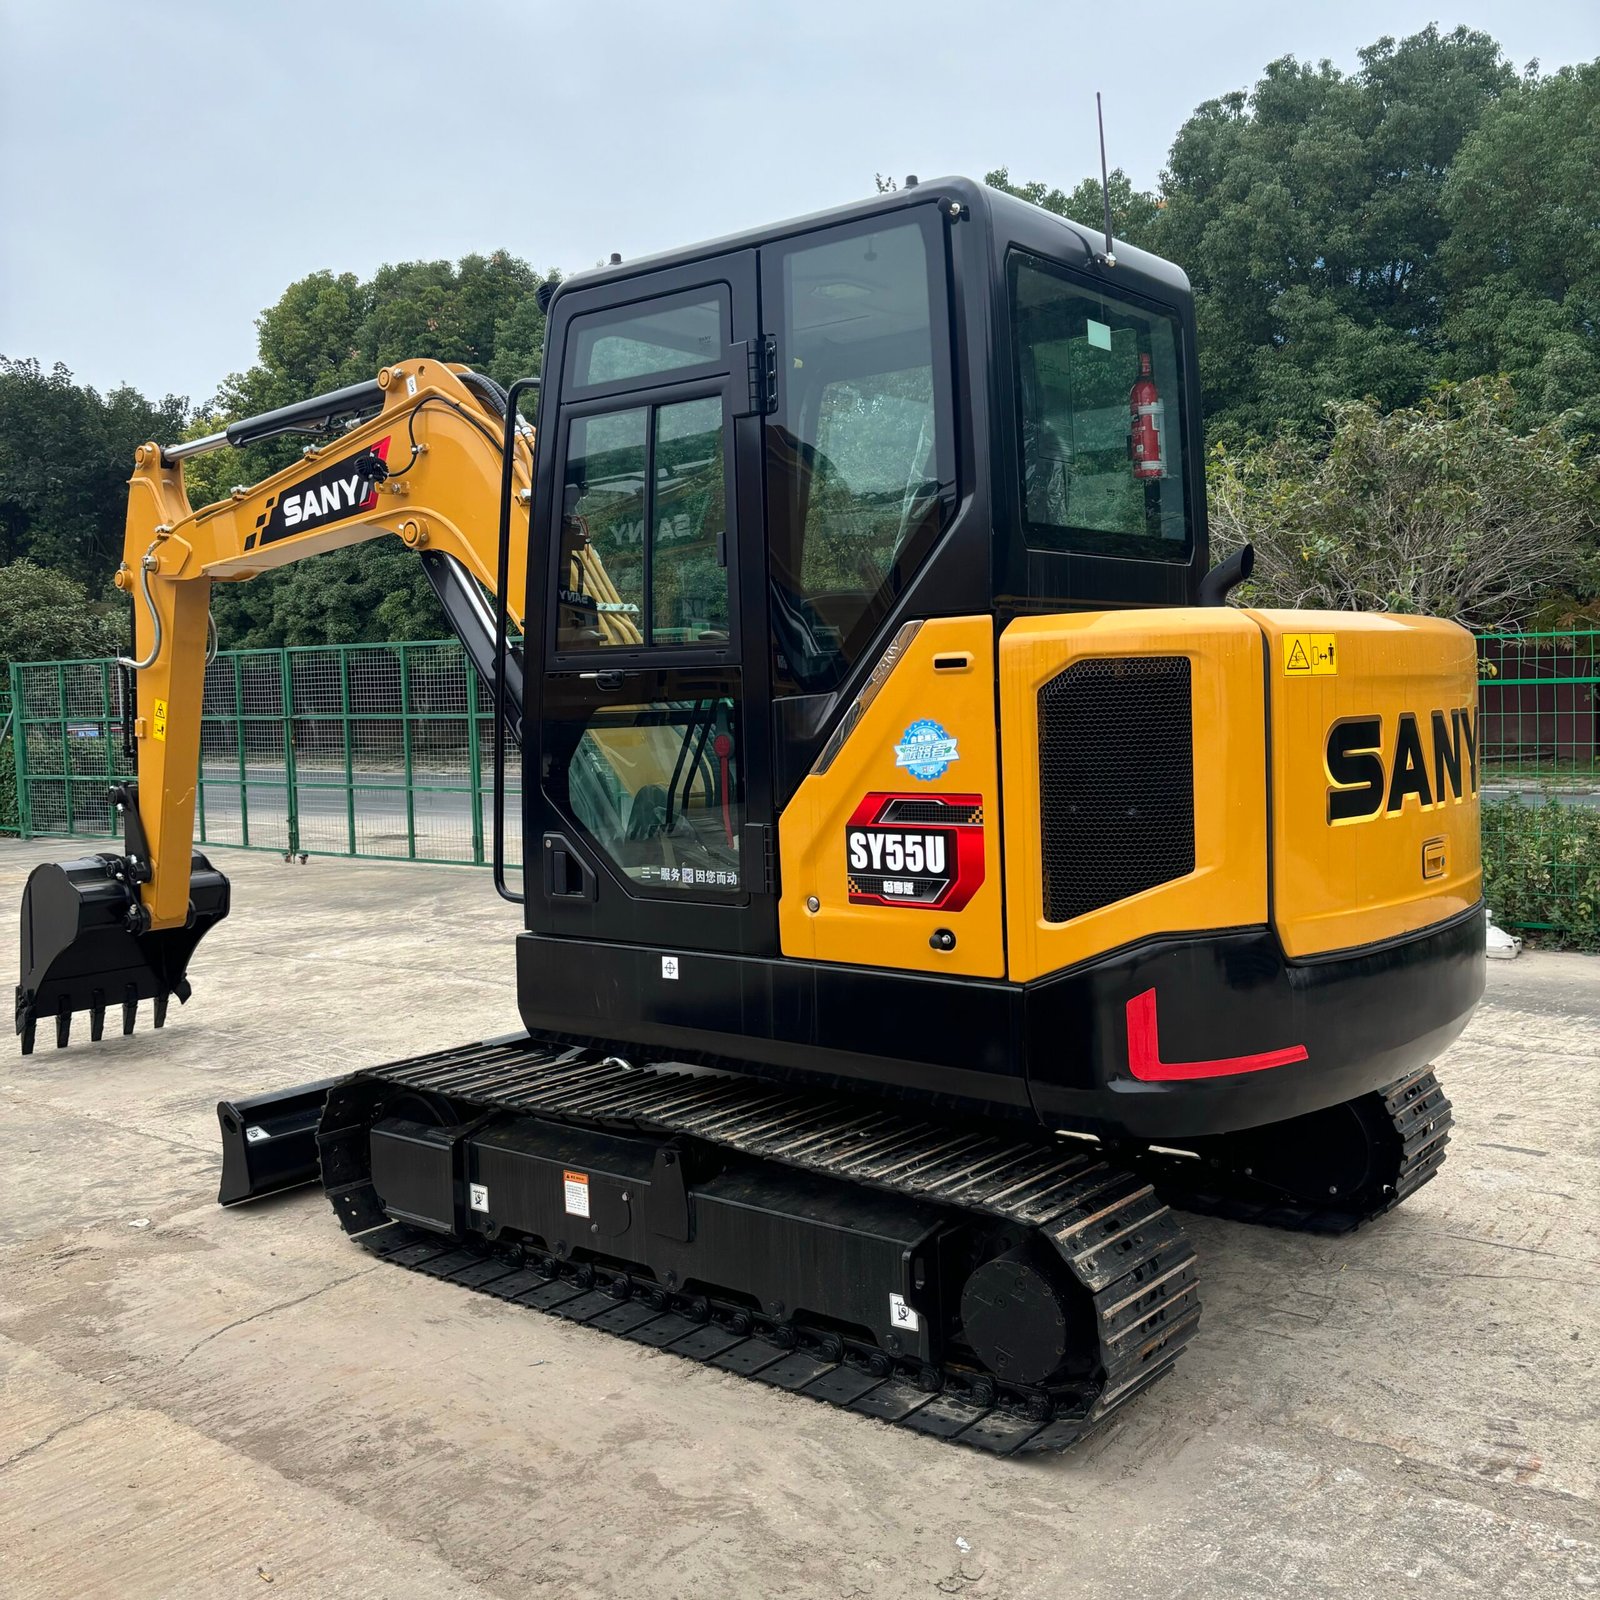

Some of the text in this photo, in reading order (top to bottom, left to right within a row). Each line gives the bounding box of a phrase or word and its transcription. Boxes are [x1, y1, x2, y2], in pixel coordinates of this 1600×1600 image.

[283, 474, 359, 527] SANY
[872, 640, 903, 684] SANY
[1325, 706, 1479, 824] SANY
[850, 832, 945, 874] SY55U
[641, 867, 737, 885] 三一服务 因您而动
